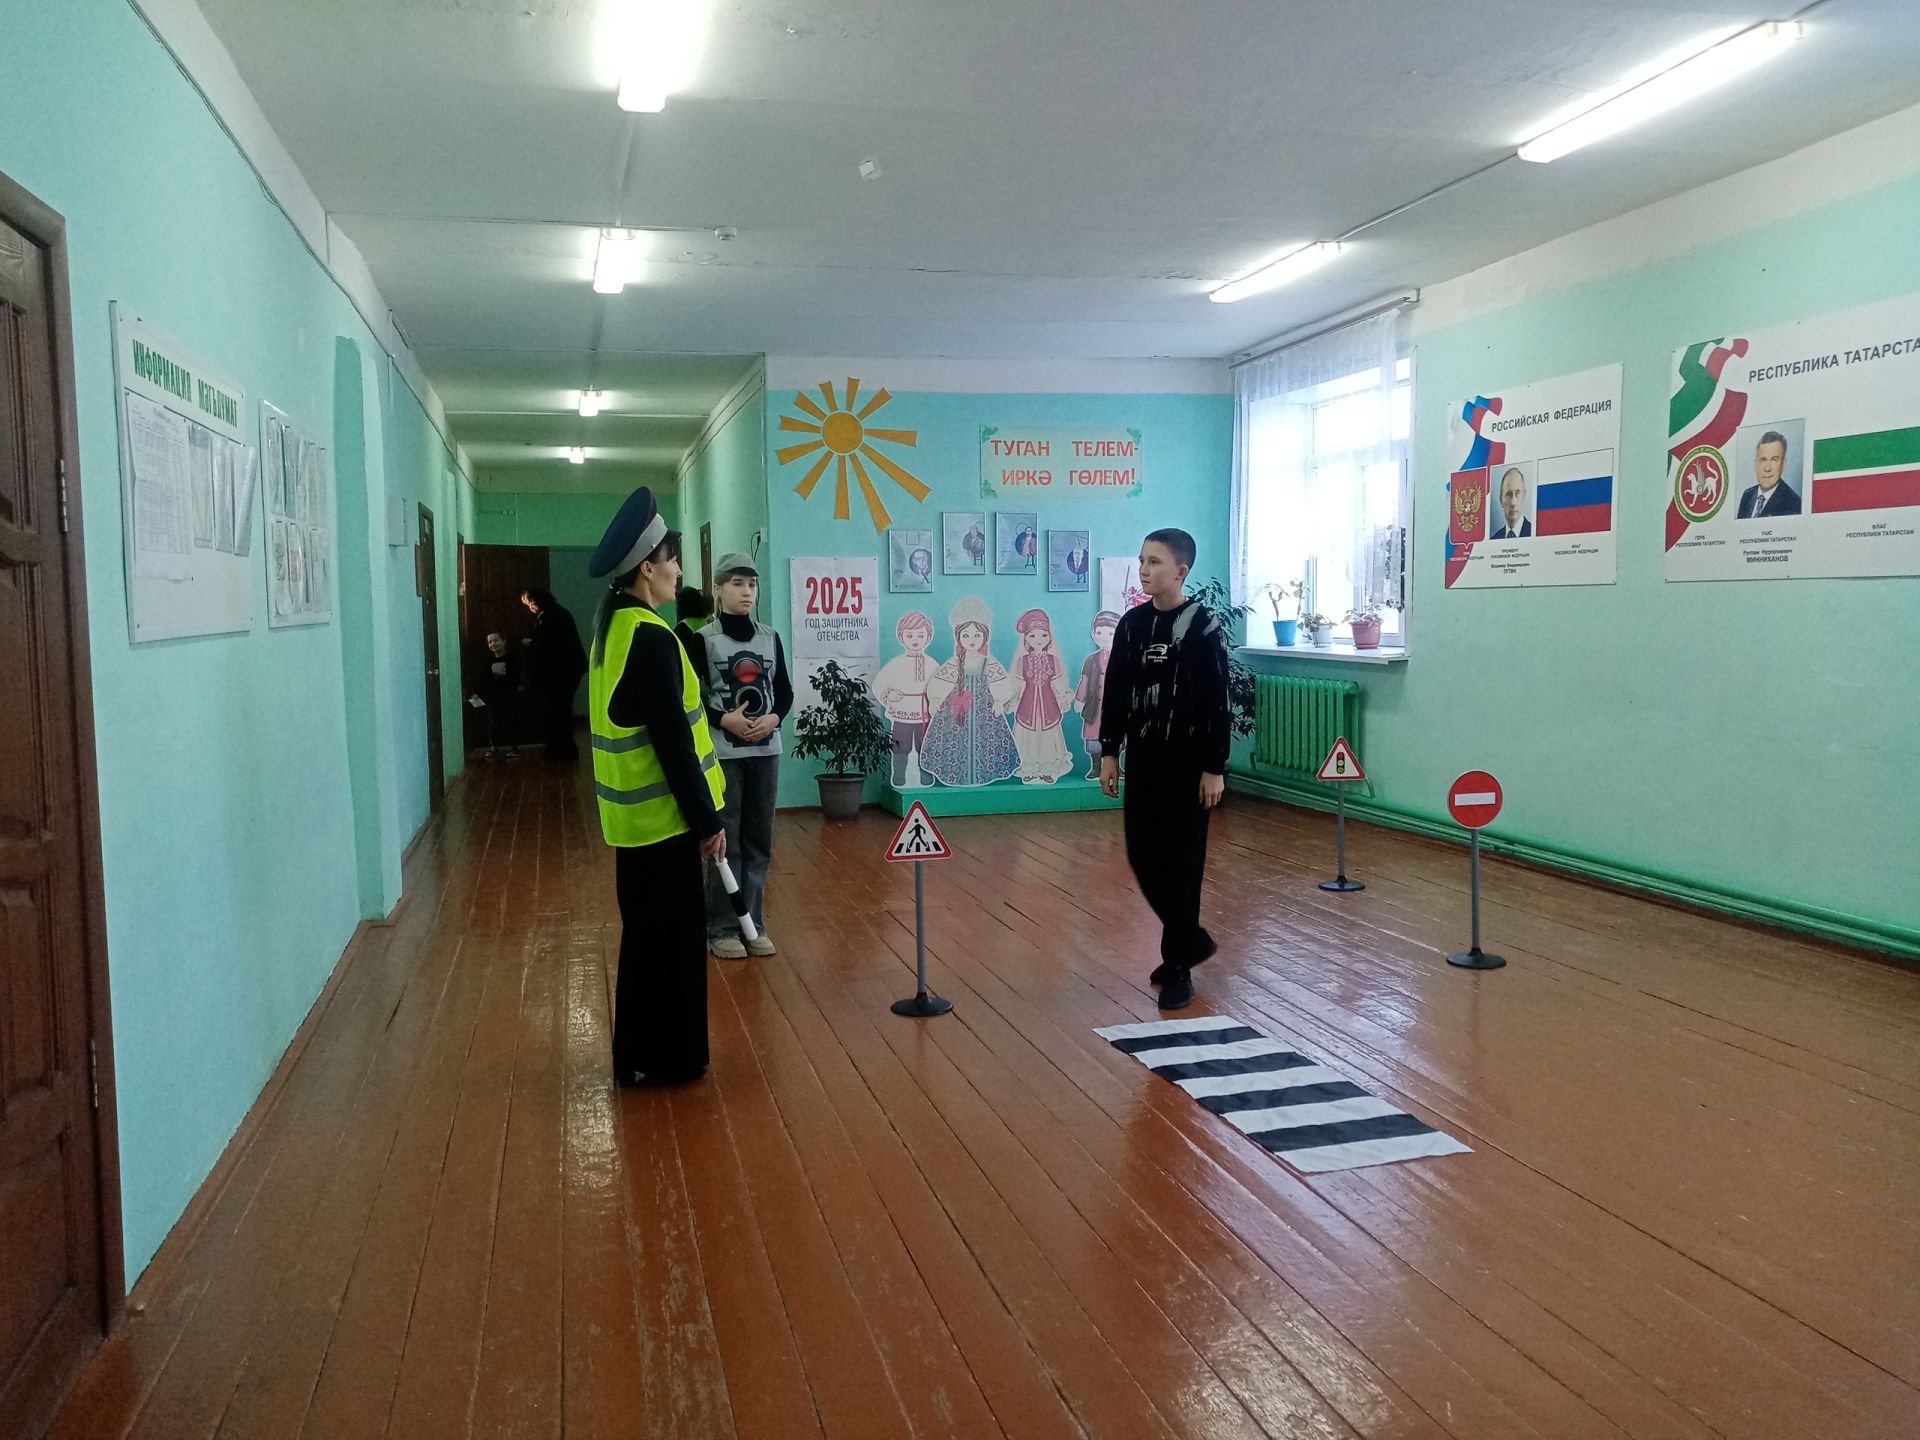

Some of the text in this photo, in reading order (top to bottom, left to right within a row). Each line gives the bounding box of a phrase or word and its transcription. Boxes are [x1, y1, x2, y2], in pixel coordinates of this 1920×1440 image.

[132, 338, 192, 403] ИНФОРМАЦИЯ
[1749, 337, 1920, 383] РЕСПУБЛИКА ТАТАРСТА
[1491, 399, 1612, 433] РОССИЙСКАЯ ФЕДЕРАЦИЯ
[990, 439, 1050, 457] ТУГАН
[1002, 468, 1136, 486] ИРКӘ ГӨЛЕМ!
[805, 576, 863, 615] 2025
[805, 617, 869, 630] ГОД ЗАЩИТНИКА
[816, 630, 860, 642] ОТЕЧЕСТВА
